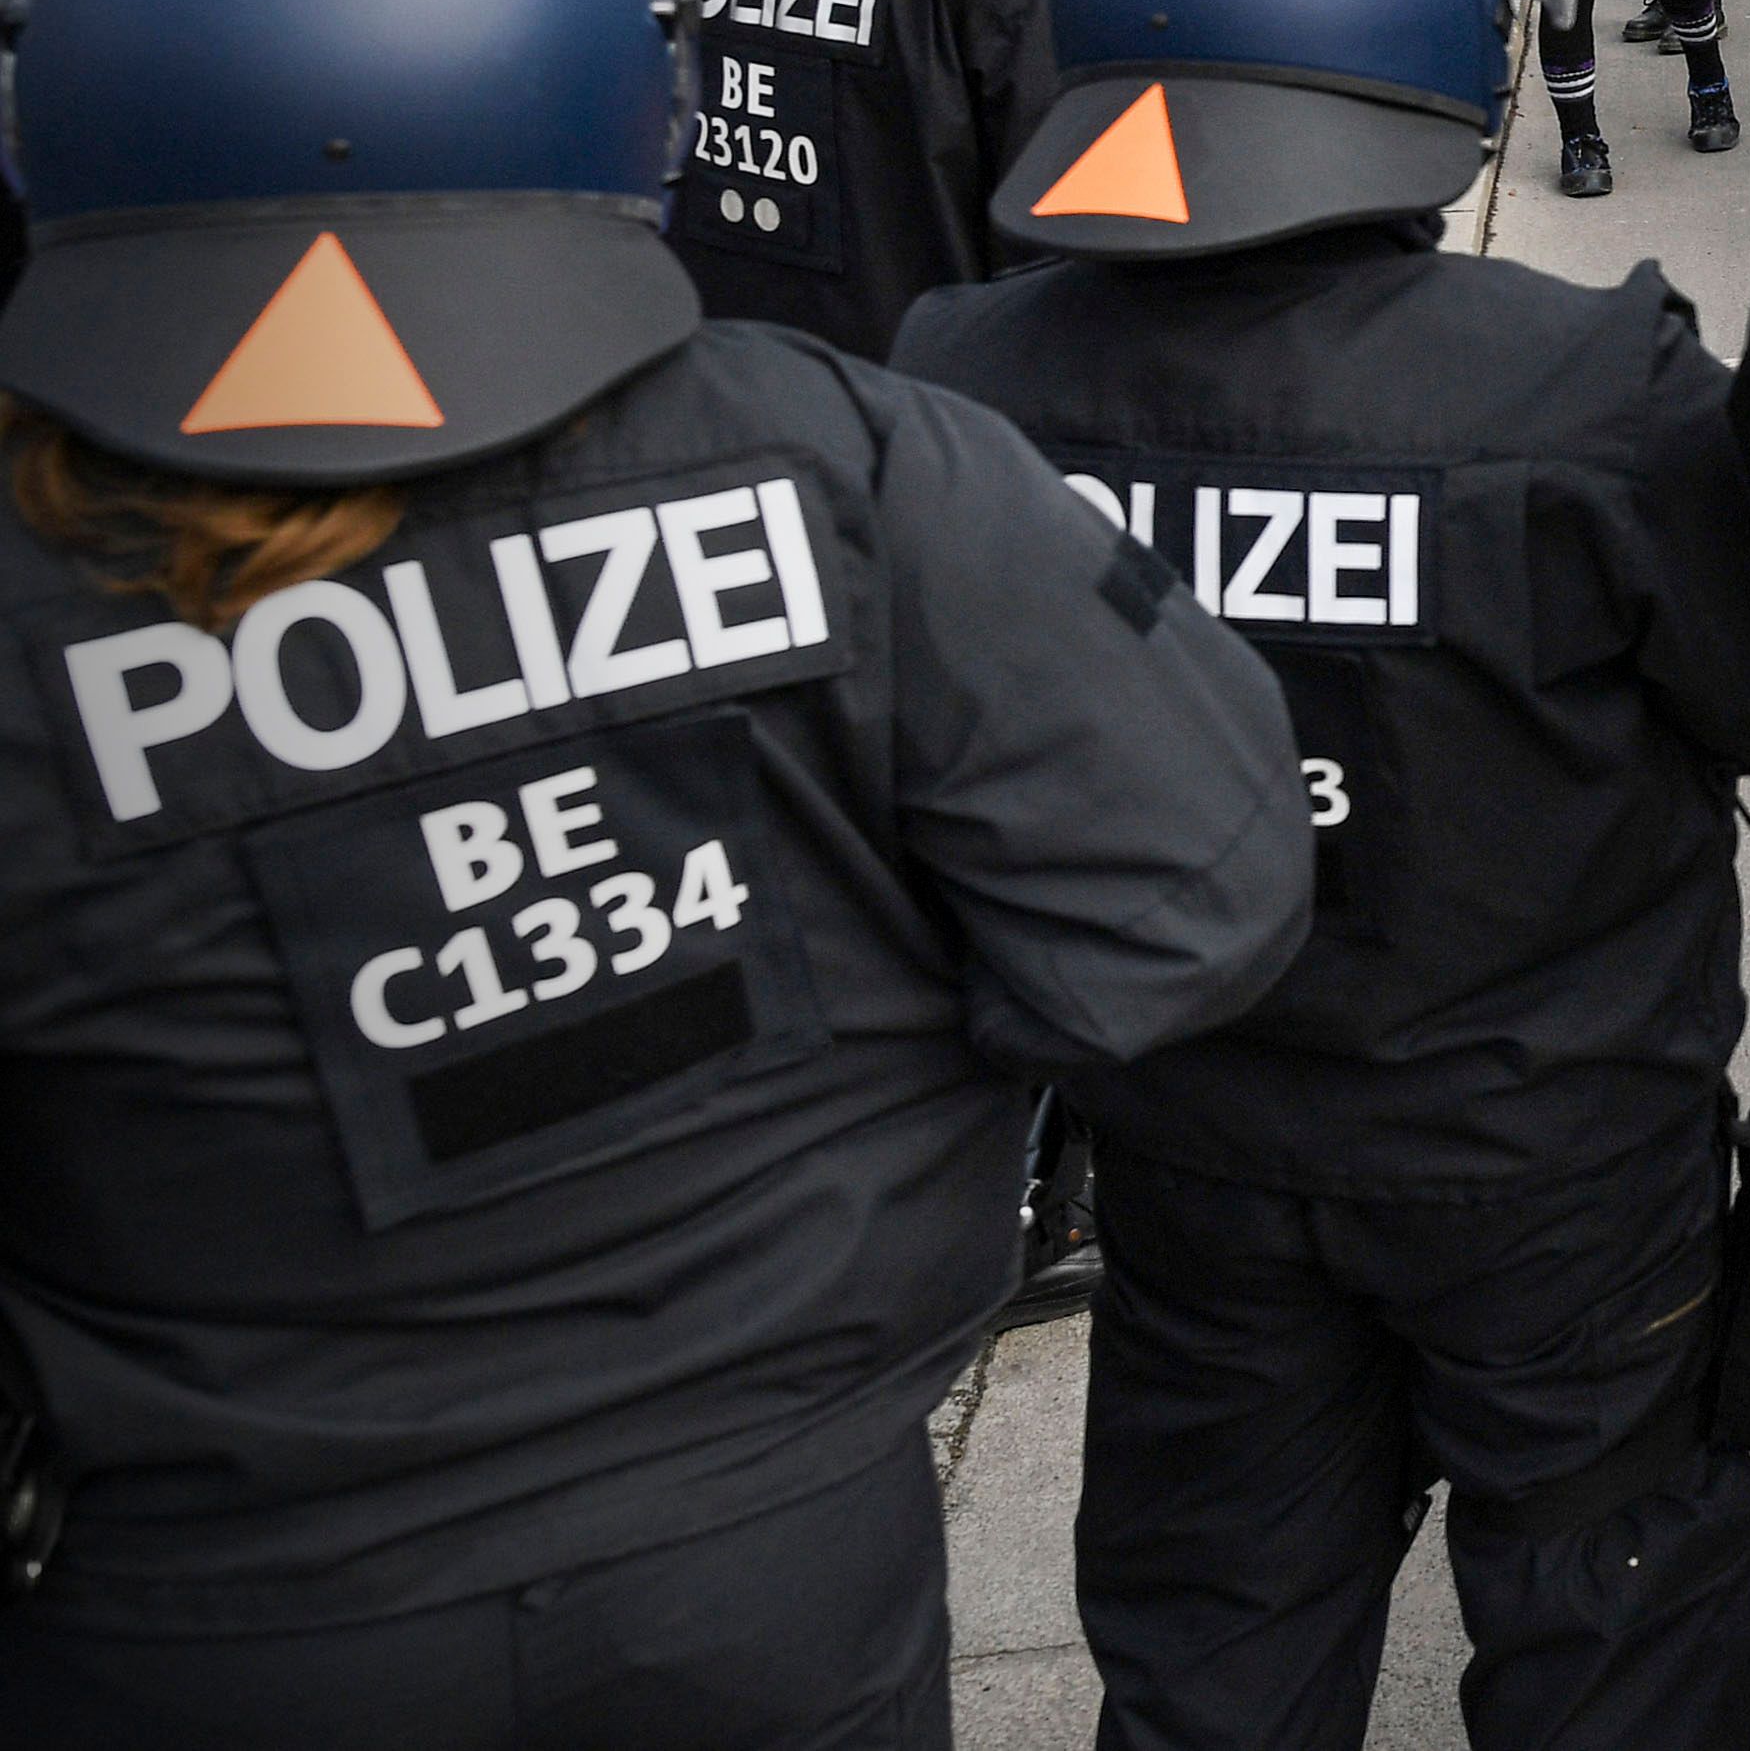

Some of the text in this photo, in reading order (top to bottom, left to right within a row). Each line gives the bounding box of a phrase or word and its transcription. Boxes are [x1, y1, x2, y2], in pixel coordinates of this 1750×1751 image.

[695, 111, 818, 185] 23120
[720, 56, 775, 118] BE
[64, 478, 830, 823] POLIZEI
[419, 766, 618, 912] BE
[350, 840, 749, 1049] C1334
